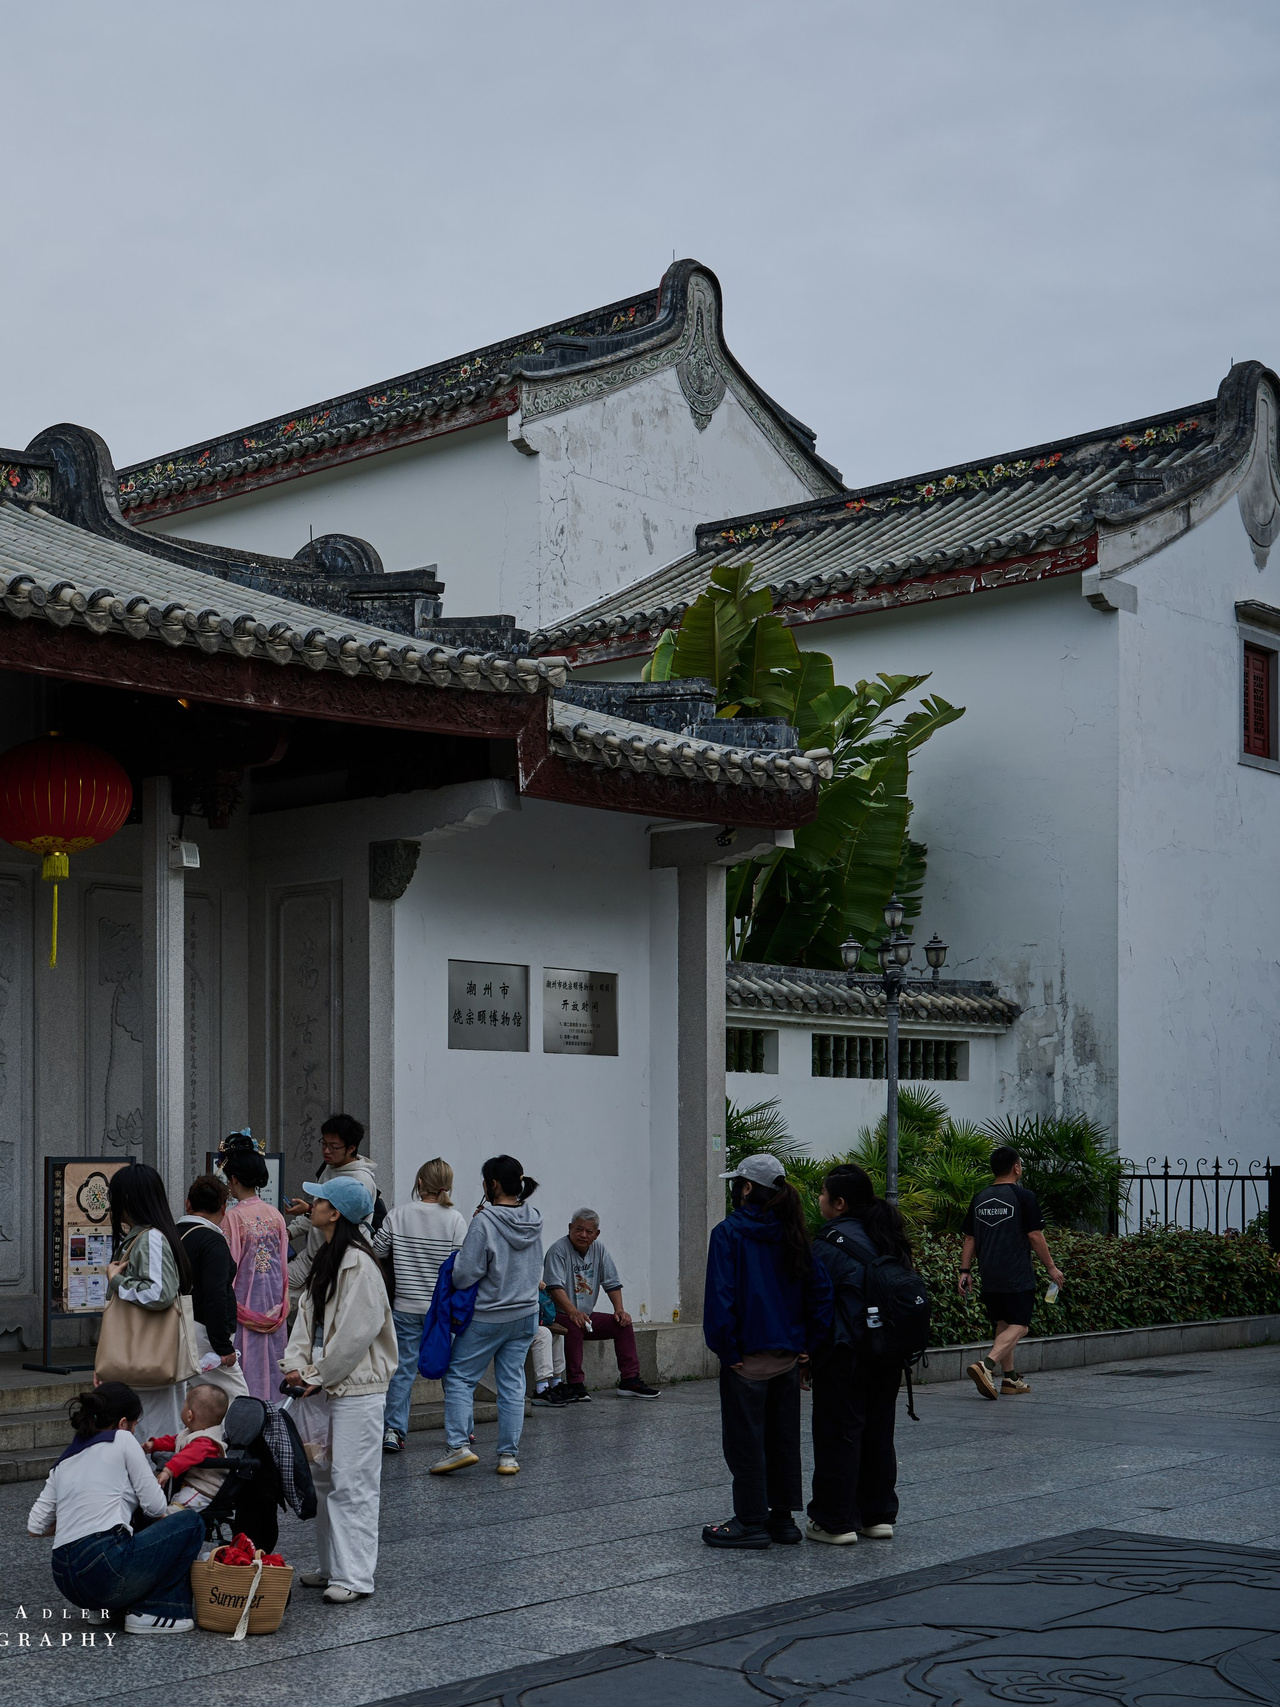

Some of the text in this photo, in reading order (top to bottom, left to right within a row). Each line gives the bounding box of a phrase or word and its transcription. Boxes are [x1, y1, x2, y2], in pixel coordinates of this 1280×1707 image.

[466, 980, 510, 1000] 潮州市
[561, 999, 599, 1013] 开放时间
[452, 1008, 523, 1028] 饶宗颐博物馆
[209, 1586, 264, 1609] Summer
